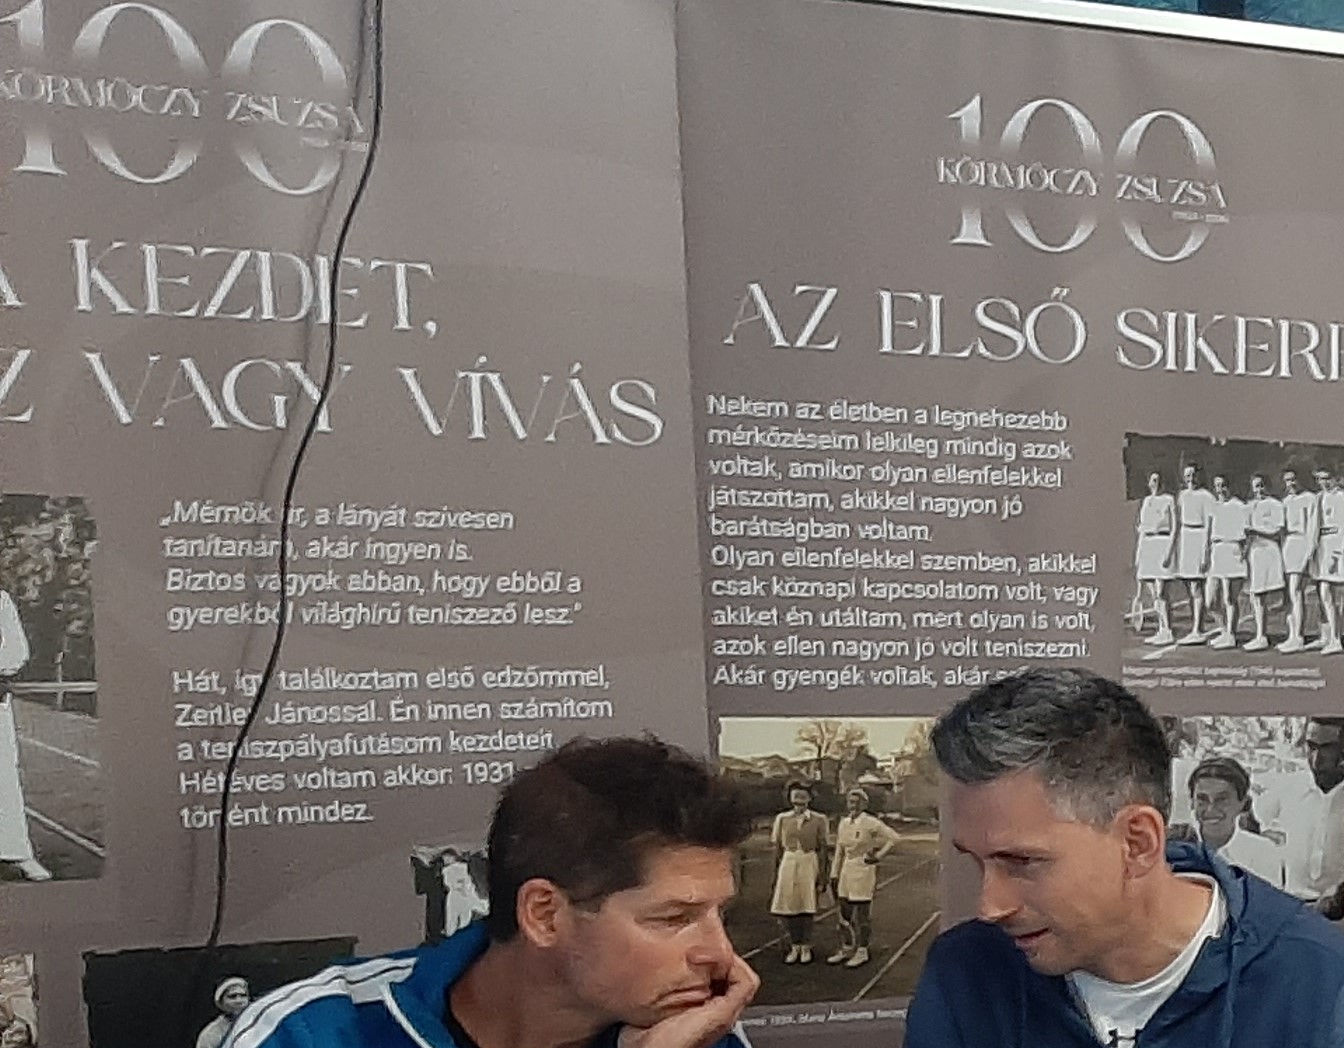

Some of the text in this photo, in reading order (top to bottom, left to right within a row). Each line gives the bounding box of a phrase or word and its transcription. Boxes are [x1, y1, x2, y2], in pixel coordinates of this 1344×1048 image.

[0, 2, 348, 195] 100
[944, 93, 1218, 262] 100
[70, 238, 438, 338] KEZDET,
[723, 281, 838, 352] AZ
[878, 286, 1087, 364] ELSŐ
[85, 351, 353, 433] VAGY
[397, 355, 665, 447] VÍVÁS
[707, 395, 1066, 431] Nekem az életben a legnehezebb
[708, 425, 1071, 462] mérkőzéseim lelkileg mindig azok
[709, 454, 1061, 487] voltak, amikor olyan ellenfelekkel
[709, 485, 1022, 519] játszottam, akikkel nagyon jó
[710, 513, 850, 542] barátságban
[711, 545, 1096, 575] Olyan ellenfelekkel szemben, akikkel
[712, 576, 768, 596] csak
[772, 576, 855, 601] köznapi
[862, 577, 998, 602] kapcsolatom
[1052, 587, 1098, 607] vagy
[712, 605, 777, 625] akiket
[785, 606, 813, 628] én
[820, 607, 906, 630] utáltam,
[913, 611, 963, 628] mert
[969, 609, 1024, 633] olyan
[1031, 610, 1048, 629] is
[713, 634, 766, 655] azok
[773, 635, 825, 656] ellen
[832, 640, 909, 660] nagyon
[914, 637, 934, 662] jó
[941, 635, 978, 656] volt
[713, 664, 766, 685] Akár
[772, 665, 864, 690] gyengék
[870, 665, 937, 688] voltak,
[944, 665, 991, 682] akár
[181, 801, 270, 828] törént
